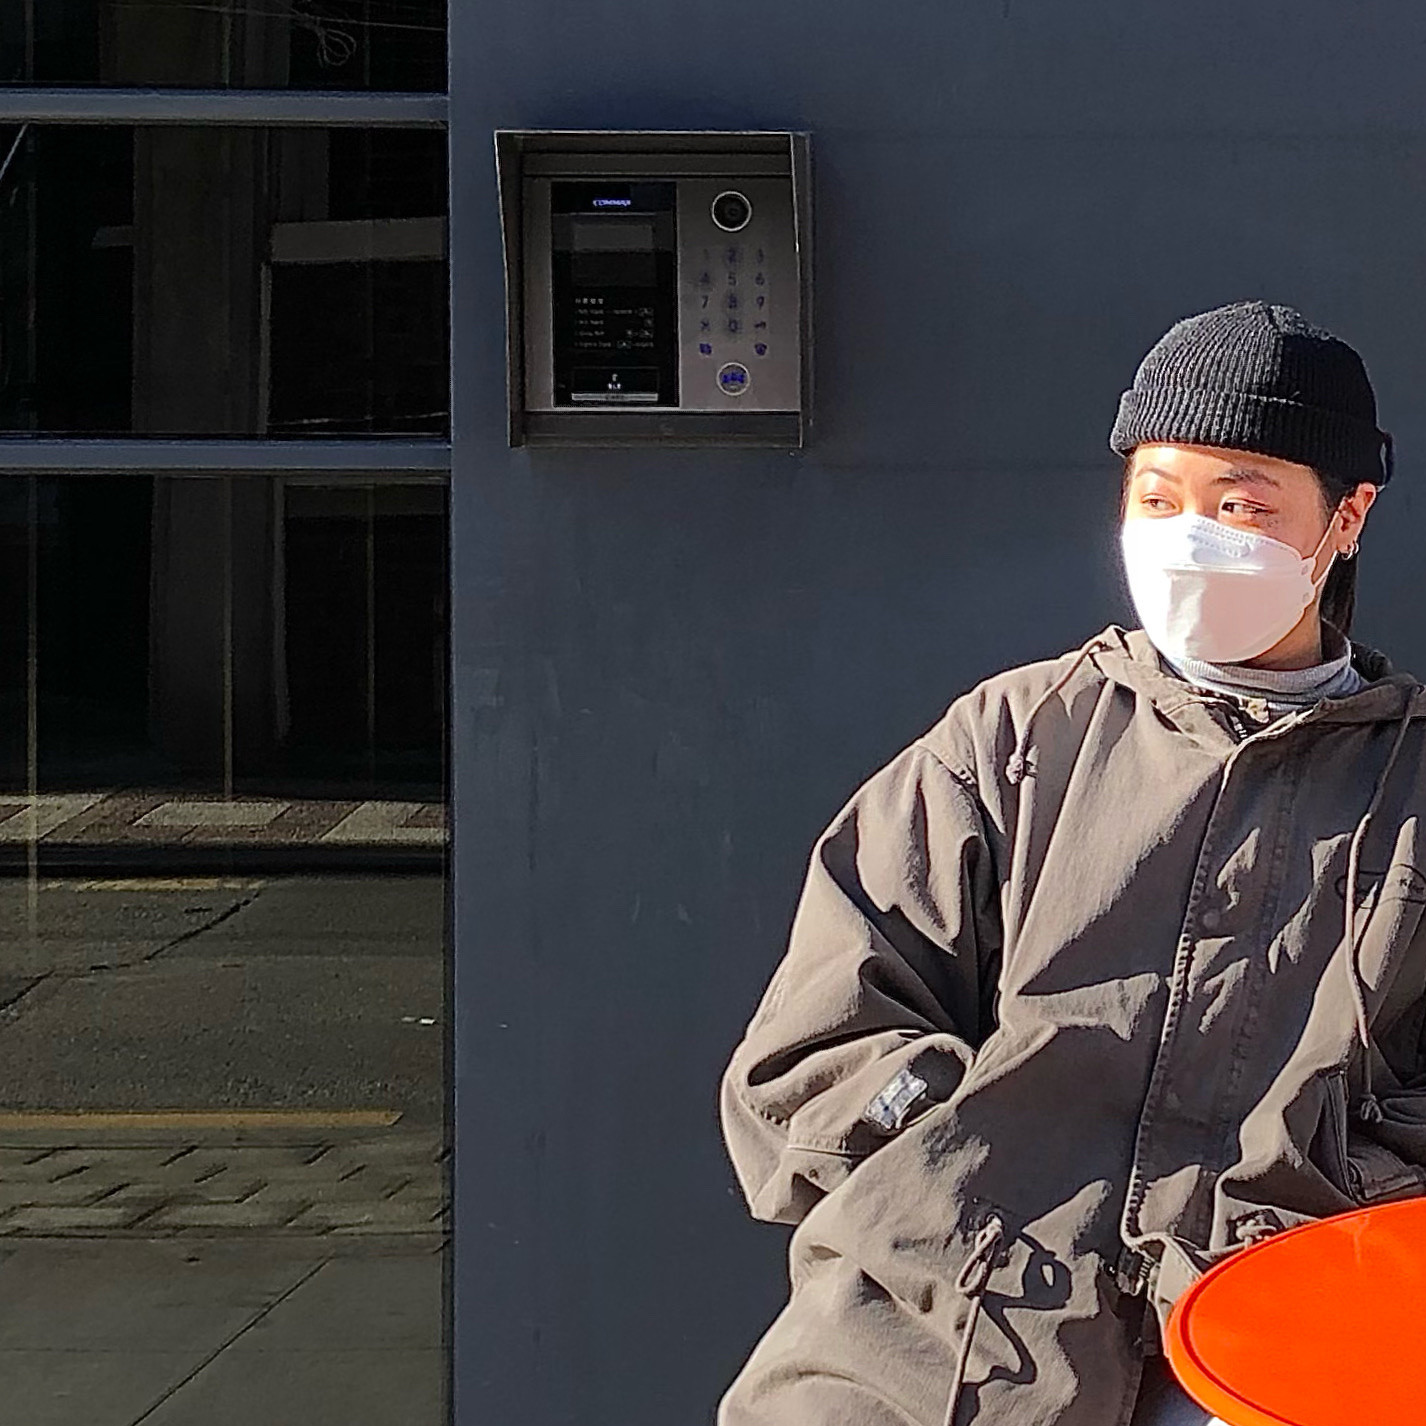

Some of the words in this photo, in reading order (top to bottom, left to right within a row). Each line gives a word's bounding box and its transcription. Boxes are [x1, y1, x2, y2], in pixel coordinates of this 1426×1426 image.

[728, 275, 737, 287] 5
[755, 272, 765, 286] 6
[701, 295, 709, 309] 7
[756, 295, 765, 310] 9
